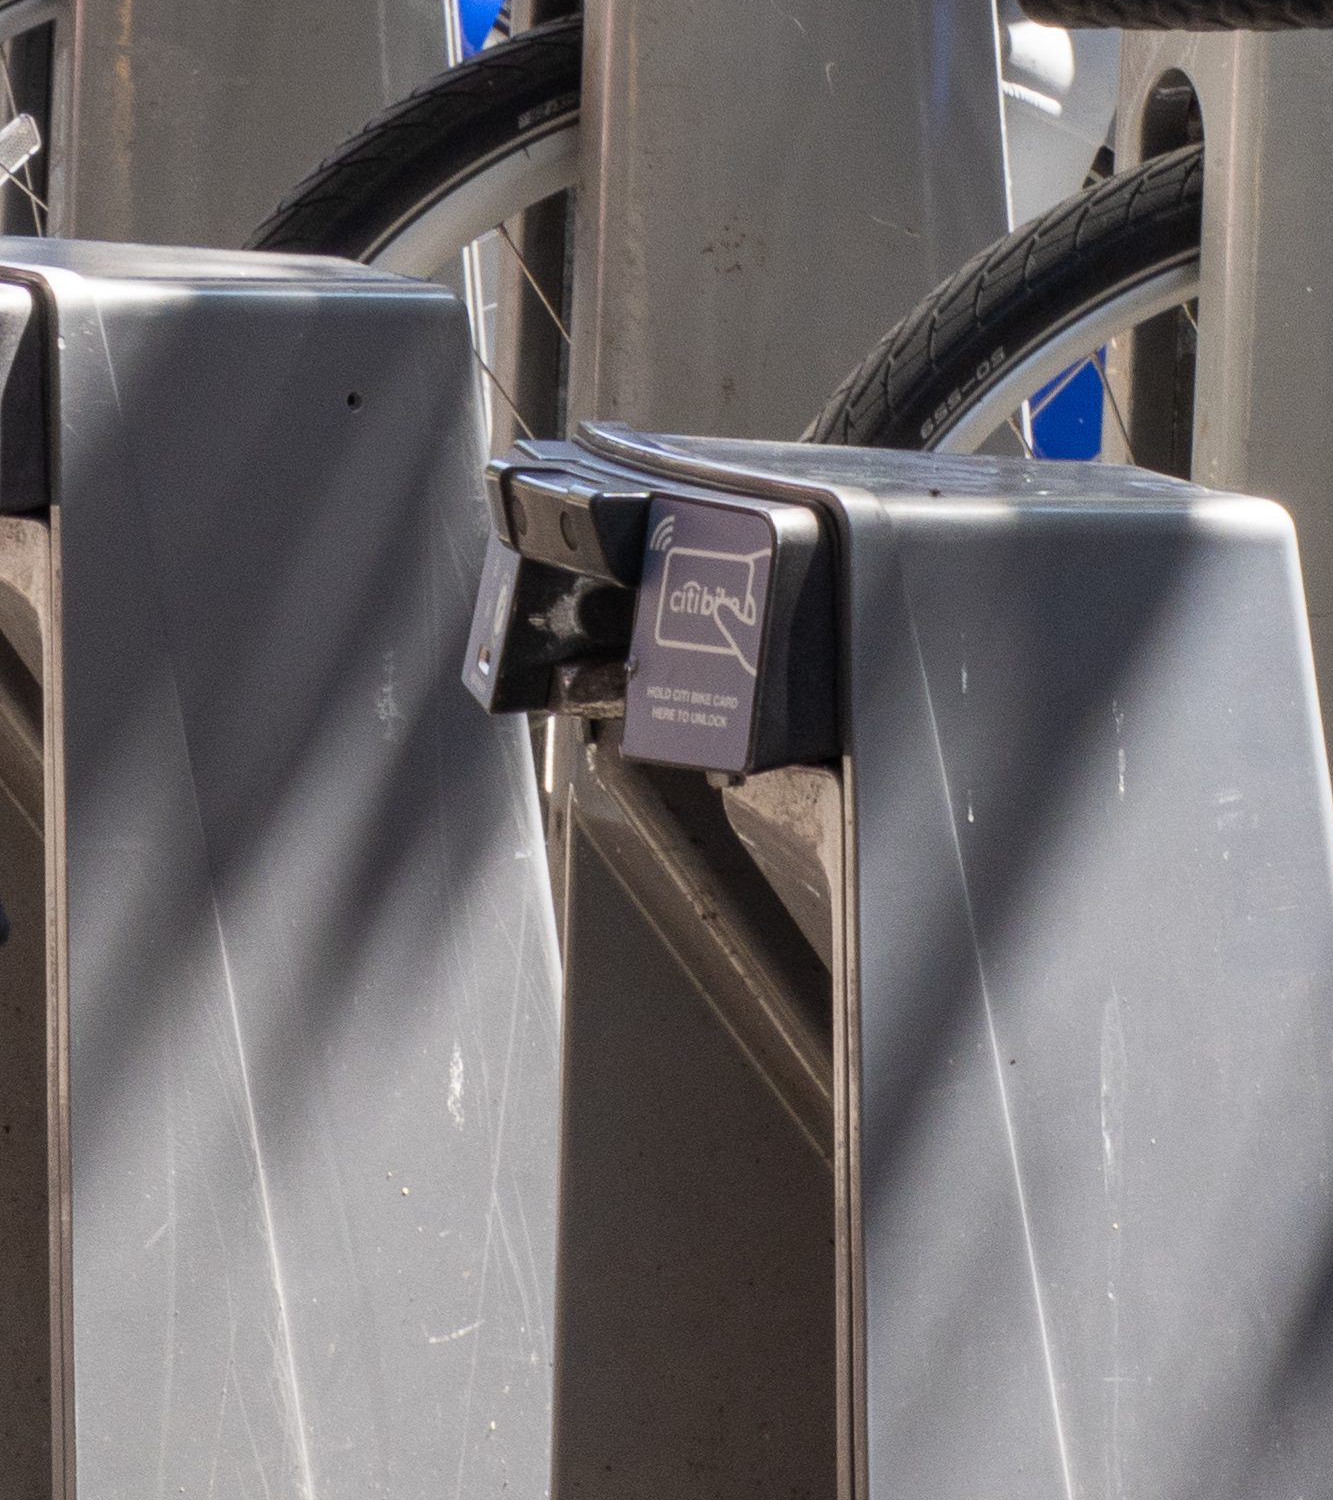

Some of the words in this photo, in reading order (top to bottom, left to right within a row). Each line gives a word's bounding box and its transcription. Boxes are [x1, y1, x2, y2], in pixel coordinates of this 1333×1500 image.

[670, 581, 701, 614] citi
[646, 685, 672, 700] HOLD
[690, 691, 713, 706] BIKE
[712, 694, 739, 709] CARD
[652, 706, 676, 721] HERE
[676, 709, 690, 723] TO
[690, 712, 728, 729] UNLOCK
